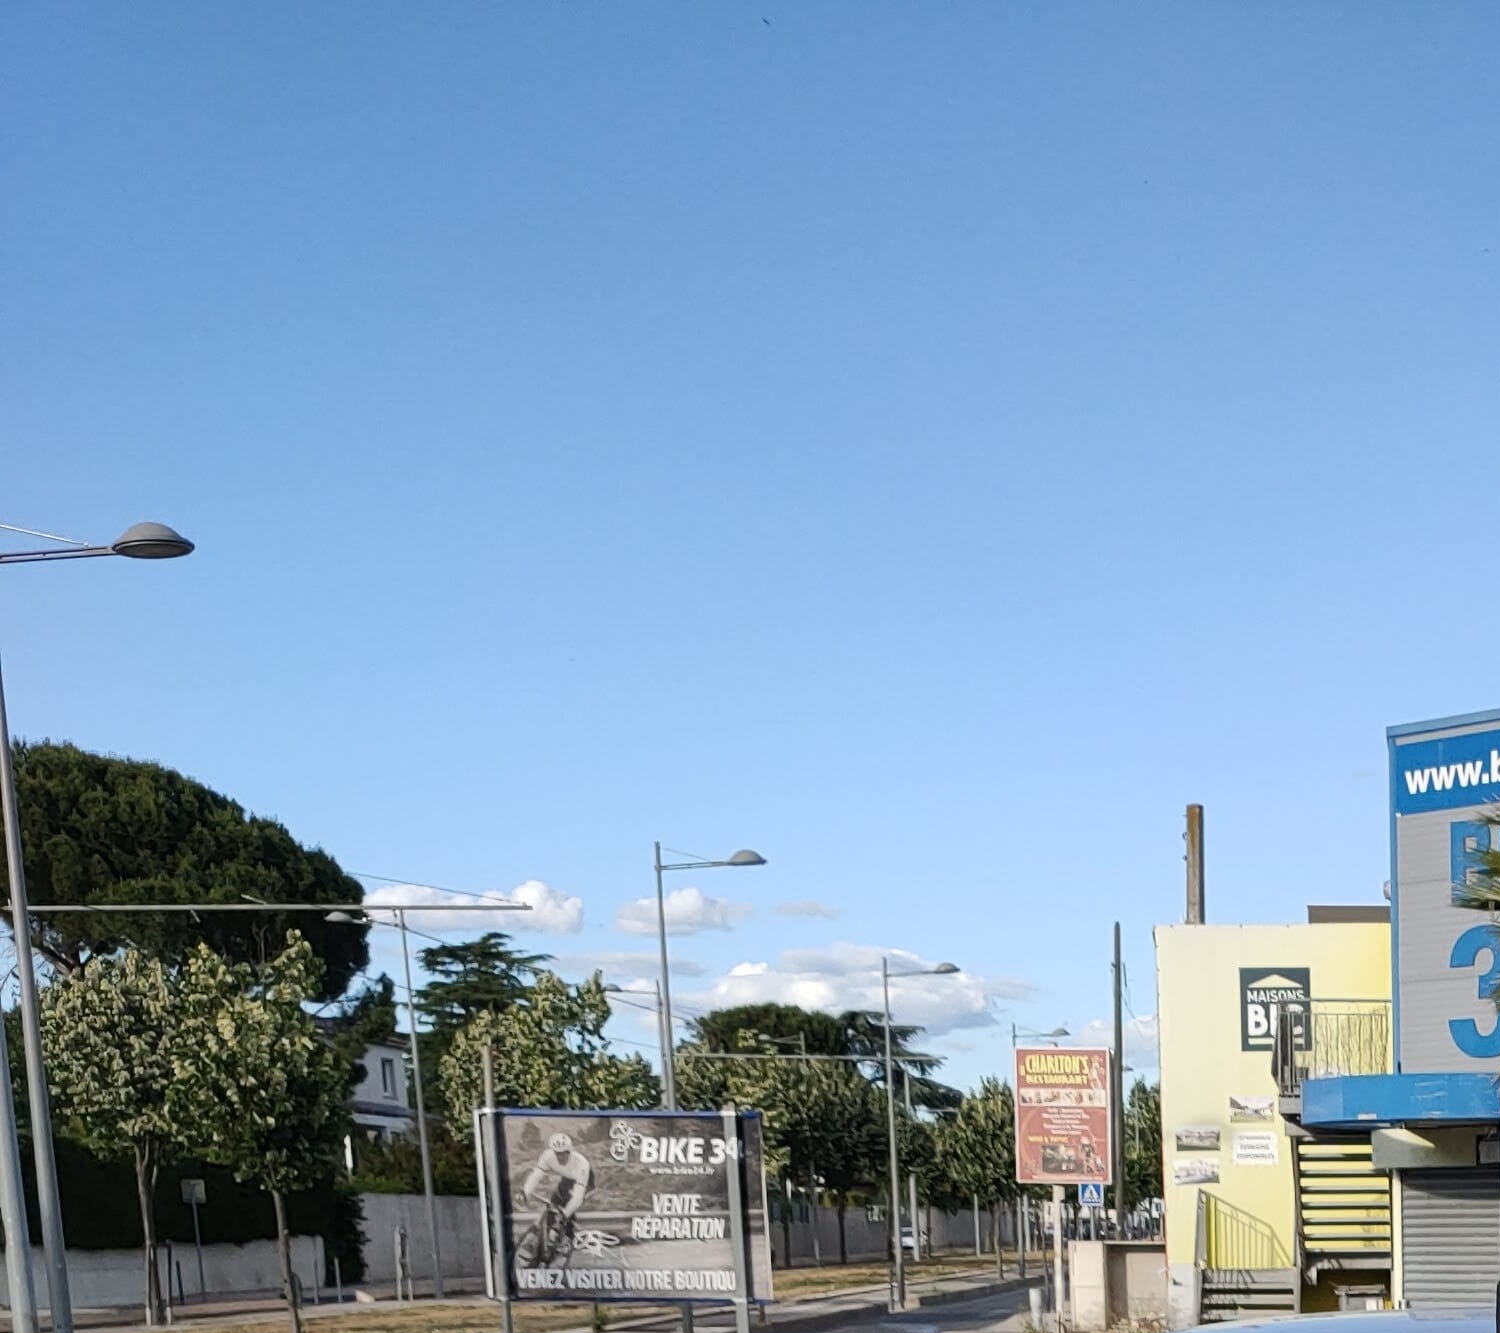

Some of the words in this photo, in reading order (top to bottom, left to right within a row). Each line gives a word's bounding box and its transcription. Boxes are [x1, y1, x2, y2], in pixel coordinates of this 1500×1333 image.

[1247, 989, 1305, 1003] MAISONS
[640, 1137, 705, 1164] BIKE
[708, 1136, 742, 1164] 34
[652, 1193, 702, 1216] VENTE
[631, 1214, 726, 1240] RÉPARATION
[516, 1268, 565, 1289] VENEZ
[566, 1269, 623, 1290] VISITER
[624, 1270, 673, 1290] NOTRE
[674, 1270, 736, 1291] BOUTIQU
